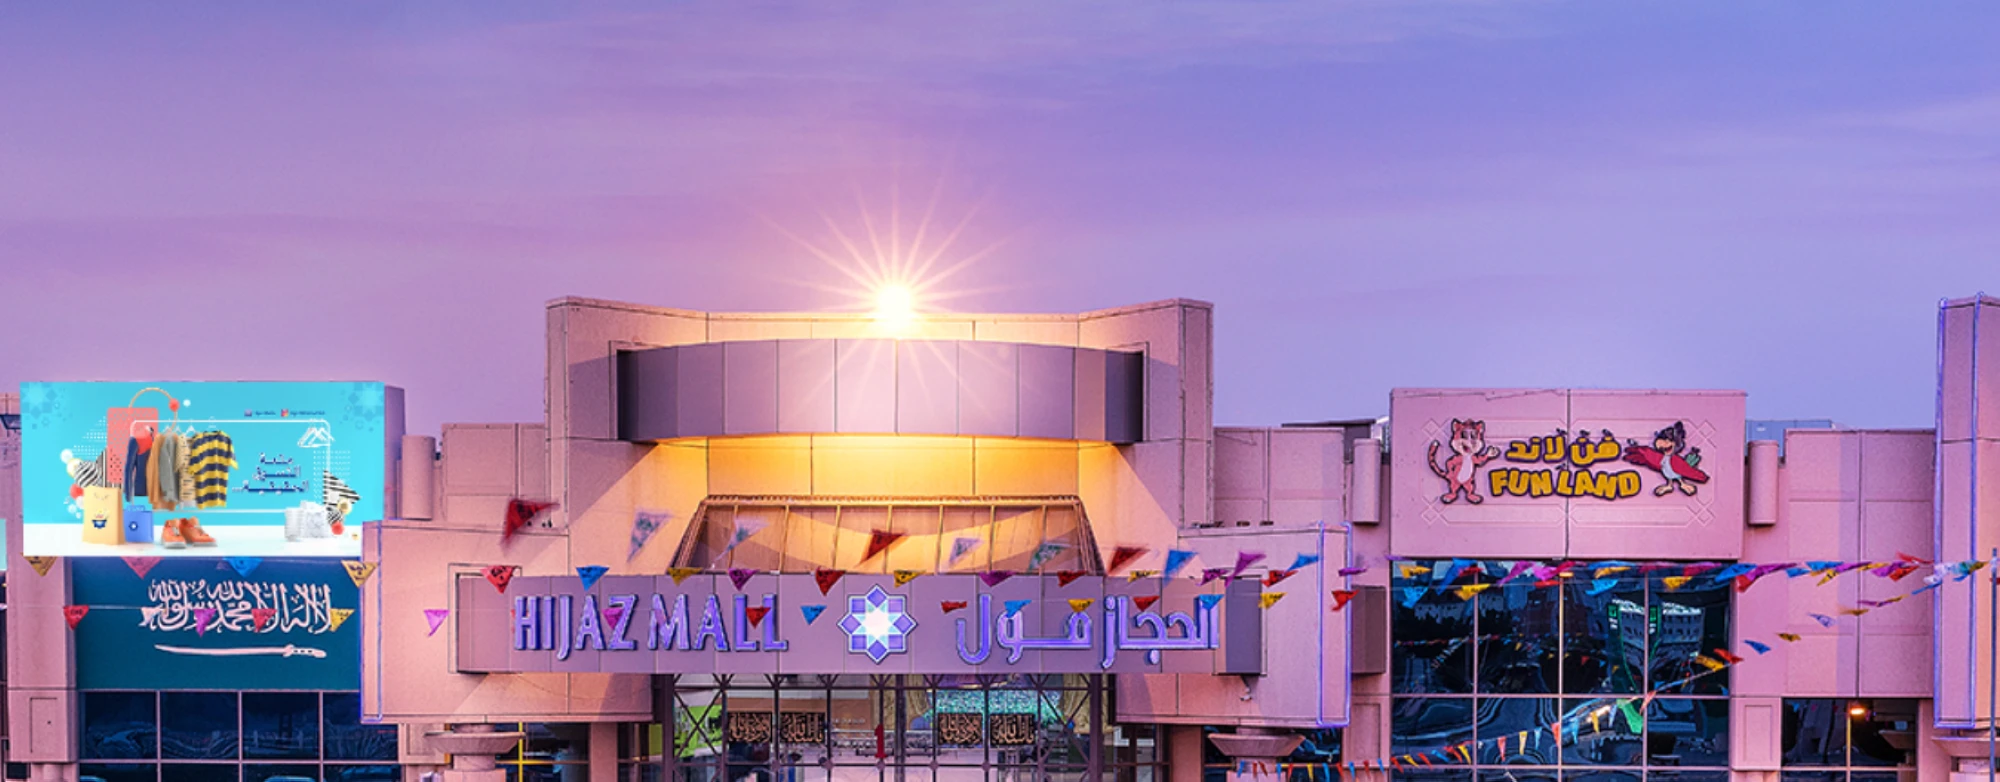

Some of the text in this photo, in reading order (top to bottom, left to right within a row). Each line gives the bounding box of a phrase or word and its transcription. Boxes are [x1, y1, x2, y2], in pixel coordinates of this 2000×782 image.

[1568, 435, 1621, 467] فن
[1489, 467, 1641, 500] FUN LAND
[513, 594, 789, 660] HIJAZ MALL
[956, 594, 1220, 669] الحجاز مول
